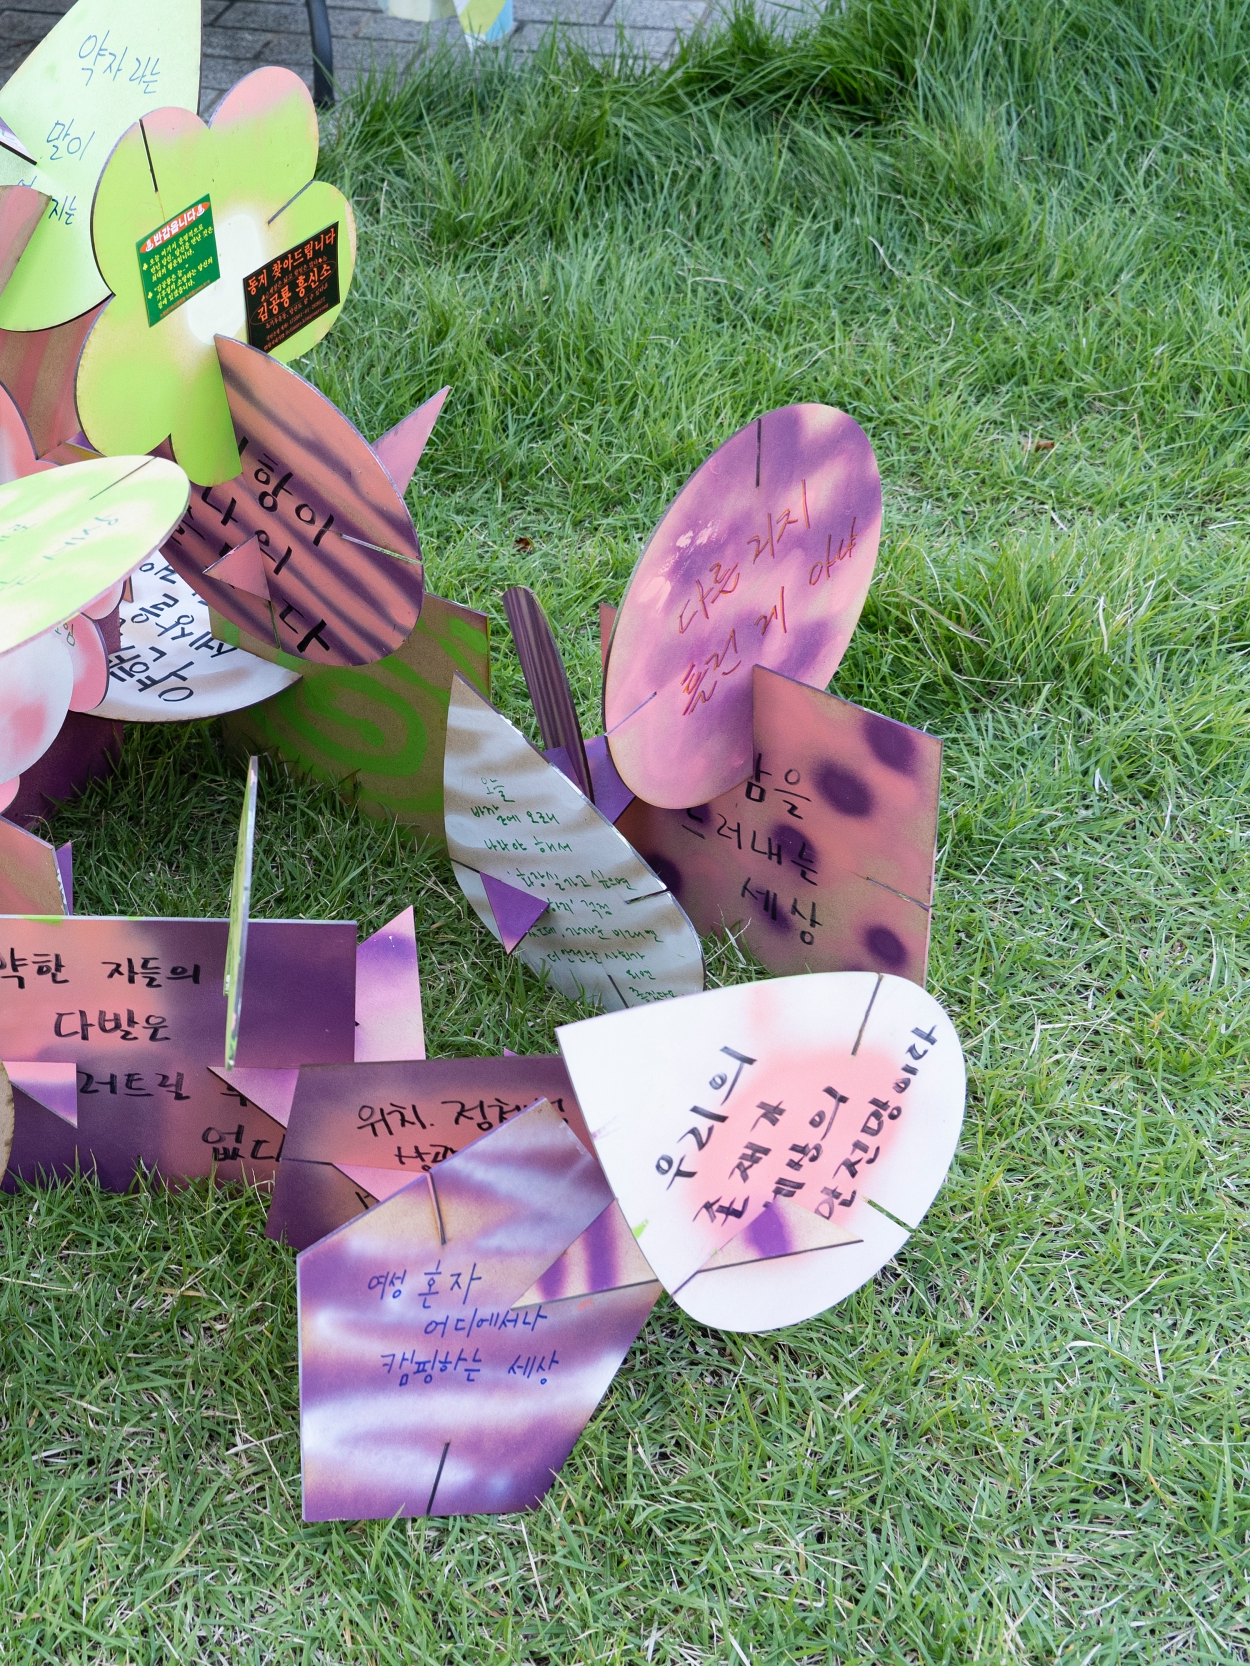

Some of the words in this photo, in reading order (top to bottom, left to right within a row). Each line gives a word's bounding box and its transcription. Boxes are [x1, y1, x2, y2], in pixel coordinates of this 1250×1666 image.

[47, 119, 94, 161] 말이
[248, 269, 267, 295] 동지
[272, 228, 336, 275] 찾아드립니다
[258, 285, 291, 322] 김공룡
[296, 260, 331, 297] 흥신소
[741, 877, 823, 946] 세상
[101, 957, 200, 988] 자들의
[54, 1009, 171, 1042] 다발은
[655, 1046, 757, 1191] 우리의
[763, 1085, 849, 1210] 세상의
[814, 1025, 937, 1221] 안전망이다
[692, 1101, 787, 1226] 존재가
[368, 1270, 406, 1300] 여성
[418, 1259, 482, 1309] 혼자
[424, 1305, 548, 1338] 어디에서나
[381, 1348, 482, 1386] 캠핑하는
[508, 1350, 559, 1385] 세상
